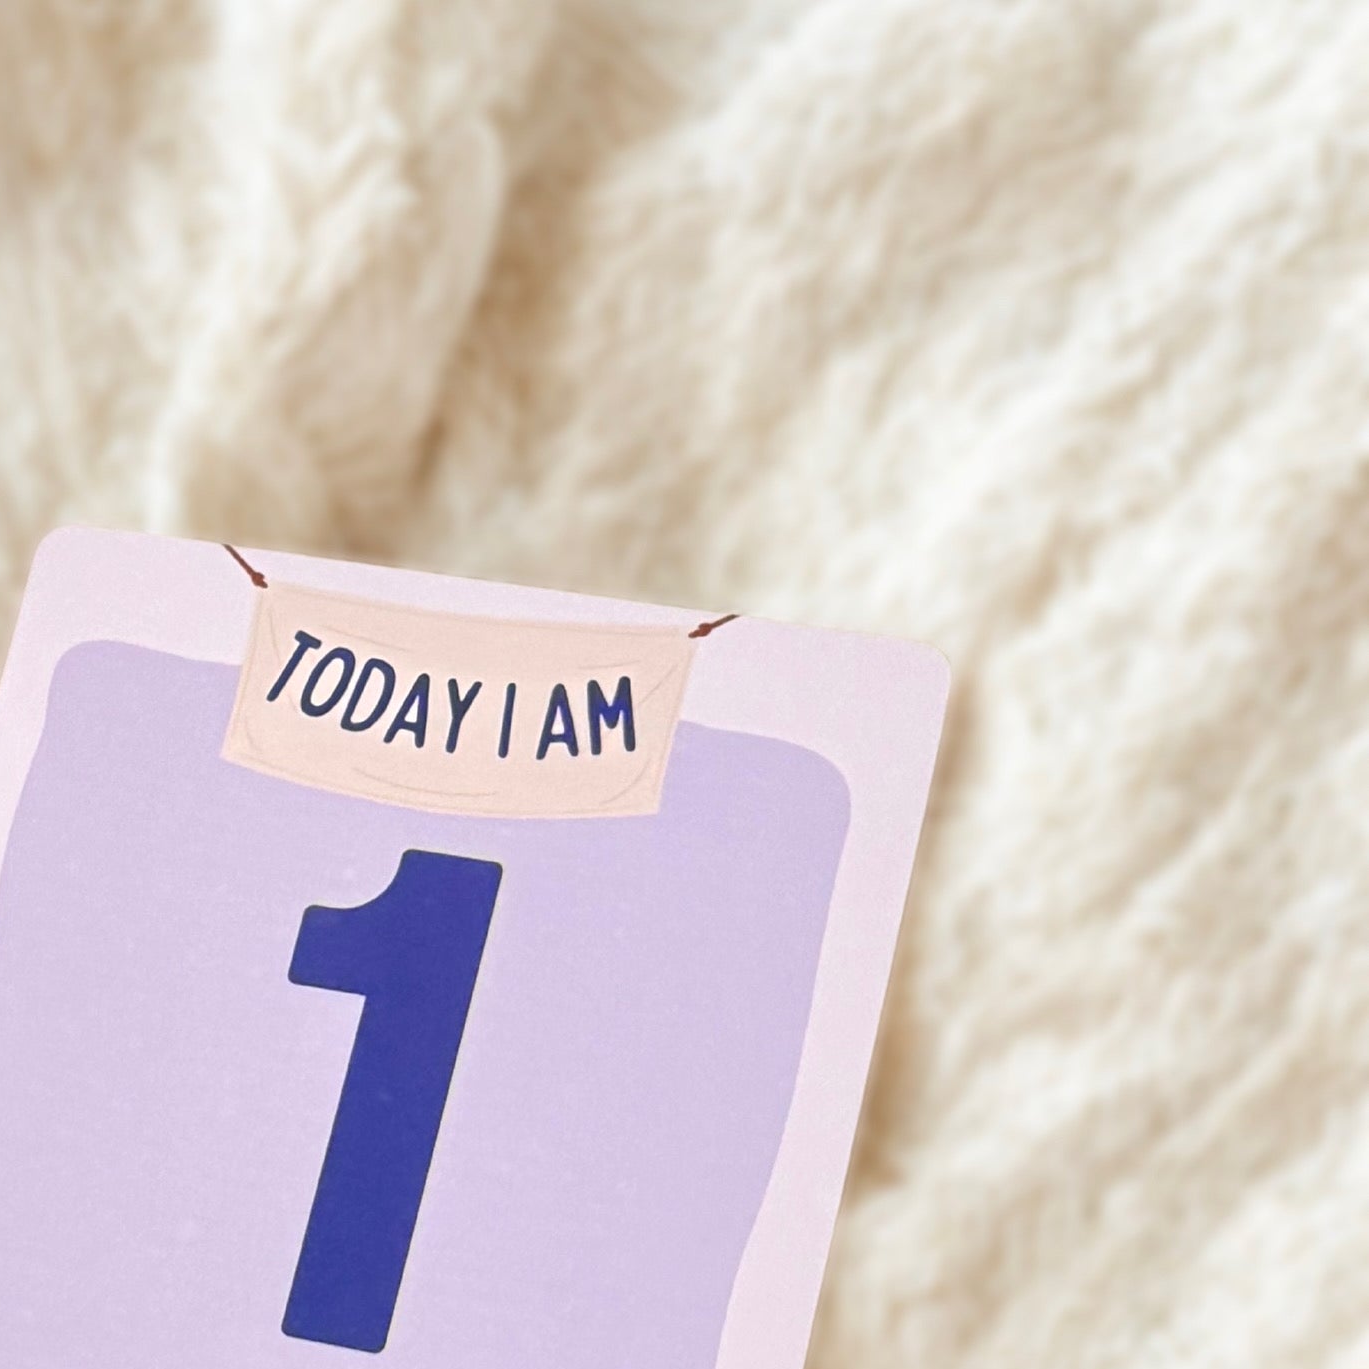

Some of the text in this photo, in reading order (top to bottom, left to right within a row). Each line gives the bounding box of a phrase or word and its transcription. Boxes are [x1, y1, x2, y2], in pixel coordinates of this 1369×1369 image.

[266, 630, 636, 761] TODAY I AM
[281, 850, 503, 1354] 1
